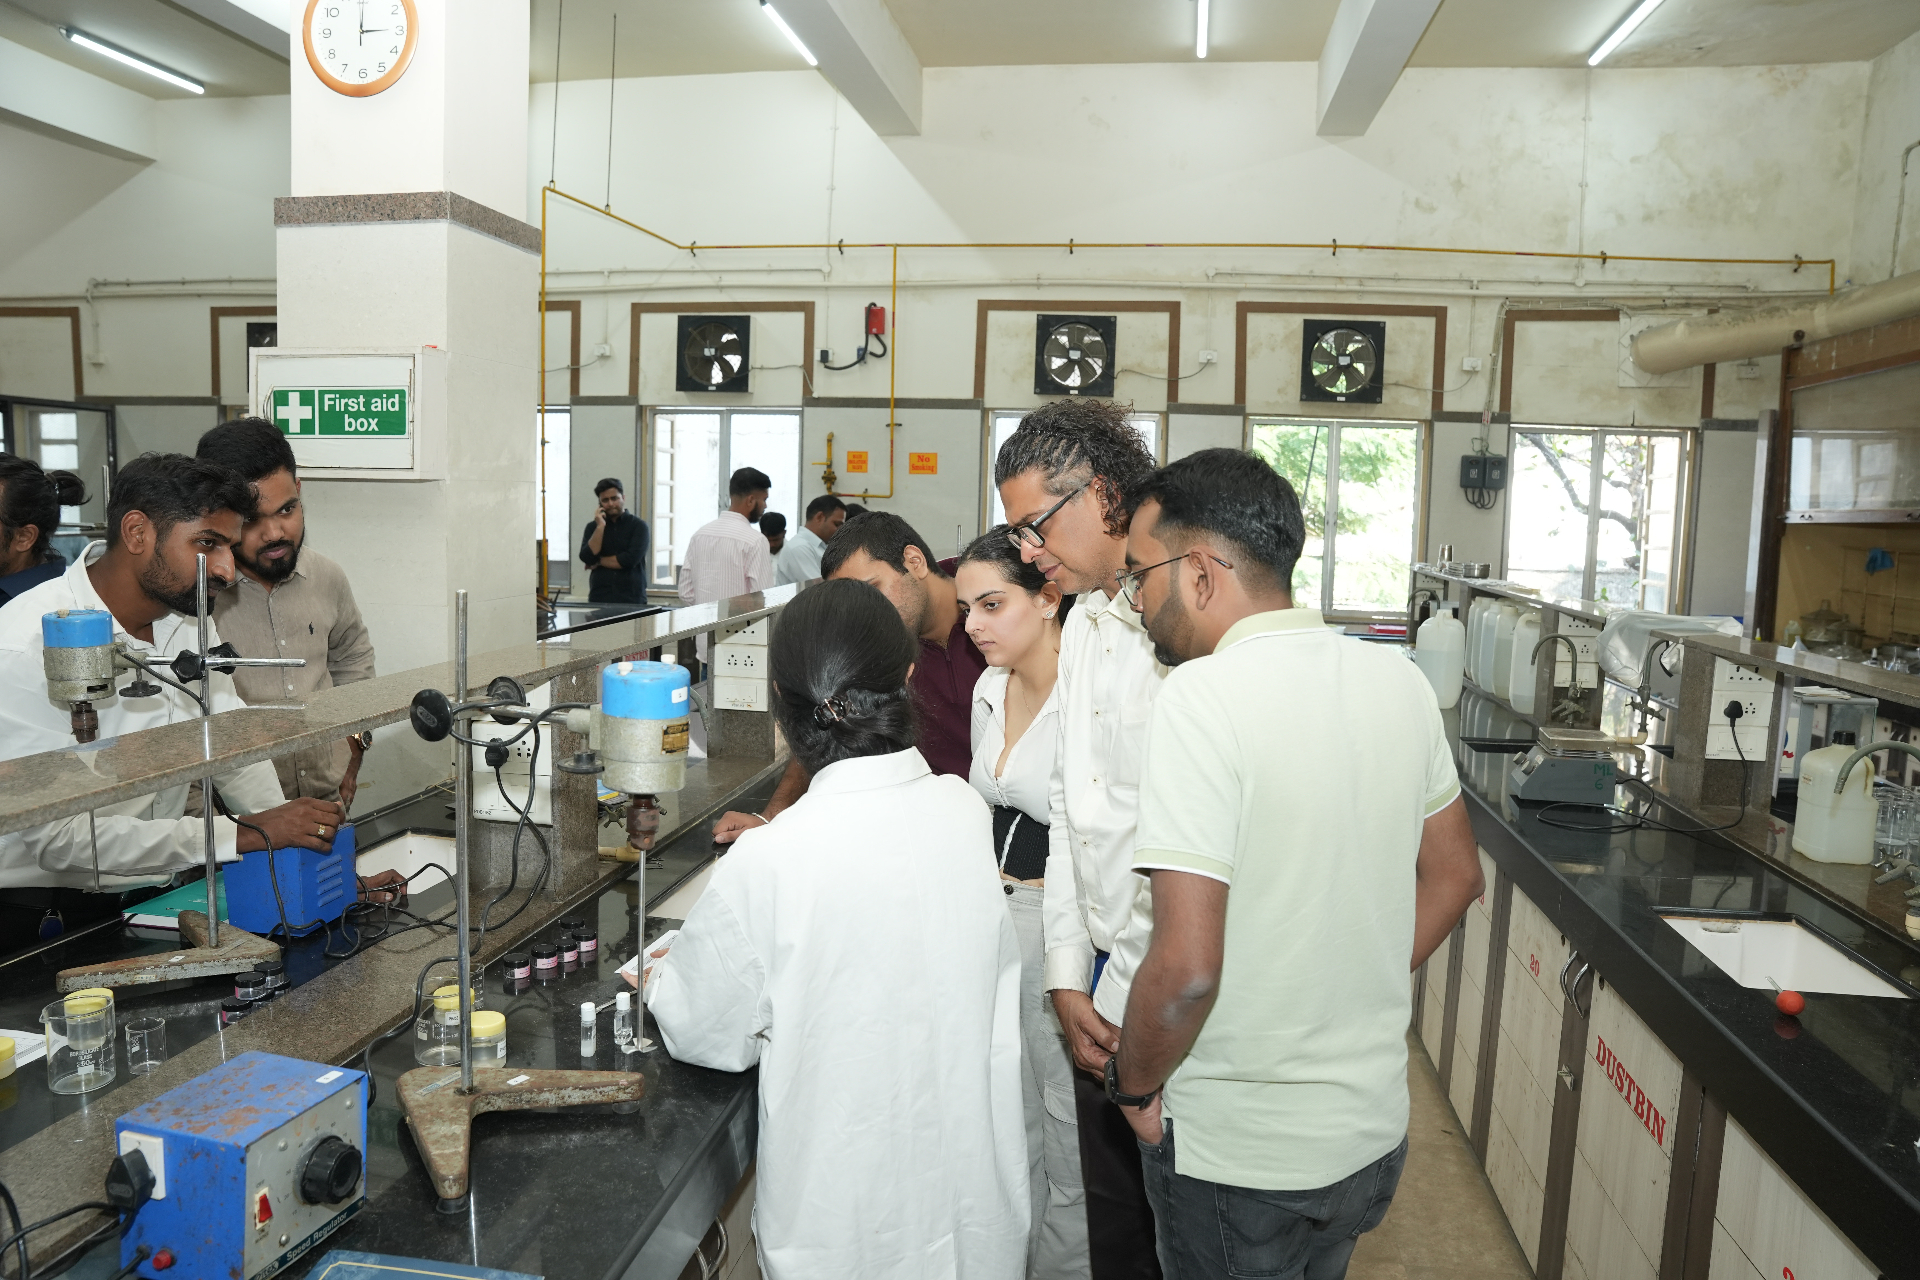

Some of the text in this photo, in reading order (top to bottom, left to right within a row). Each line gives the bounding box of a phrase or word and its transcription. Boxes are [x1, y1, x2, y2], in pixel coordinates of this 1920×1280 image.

[324, 7, 340, 18] 10
[391, 5, 399, 15] 2
[322, 28, 332, 38] 9
[394, 25, 405, 36] 3
[328, 49, 336, 59] 8
[389, 45, 399, 55] 4
[341, 63, 348, 73] 7
[376, 62, 386, 73] 5
[358, 68, 368, 79] 6
[324, 394, 399, 412] First aid
[344, 414, 379, 431] box
[911, 463, 935, 473] Smoking
[1593, 763, 1613, 776] ML
[1594, 778, 1603, 790] 6
[1529, 953, 1540, 977] 20
[1596, 1034, 1666, 1146] DUSTBIN
[286, 1237, 311, 1261] Speed
[313, 1212, 348, 1241] Regulator
